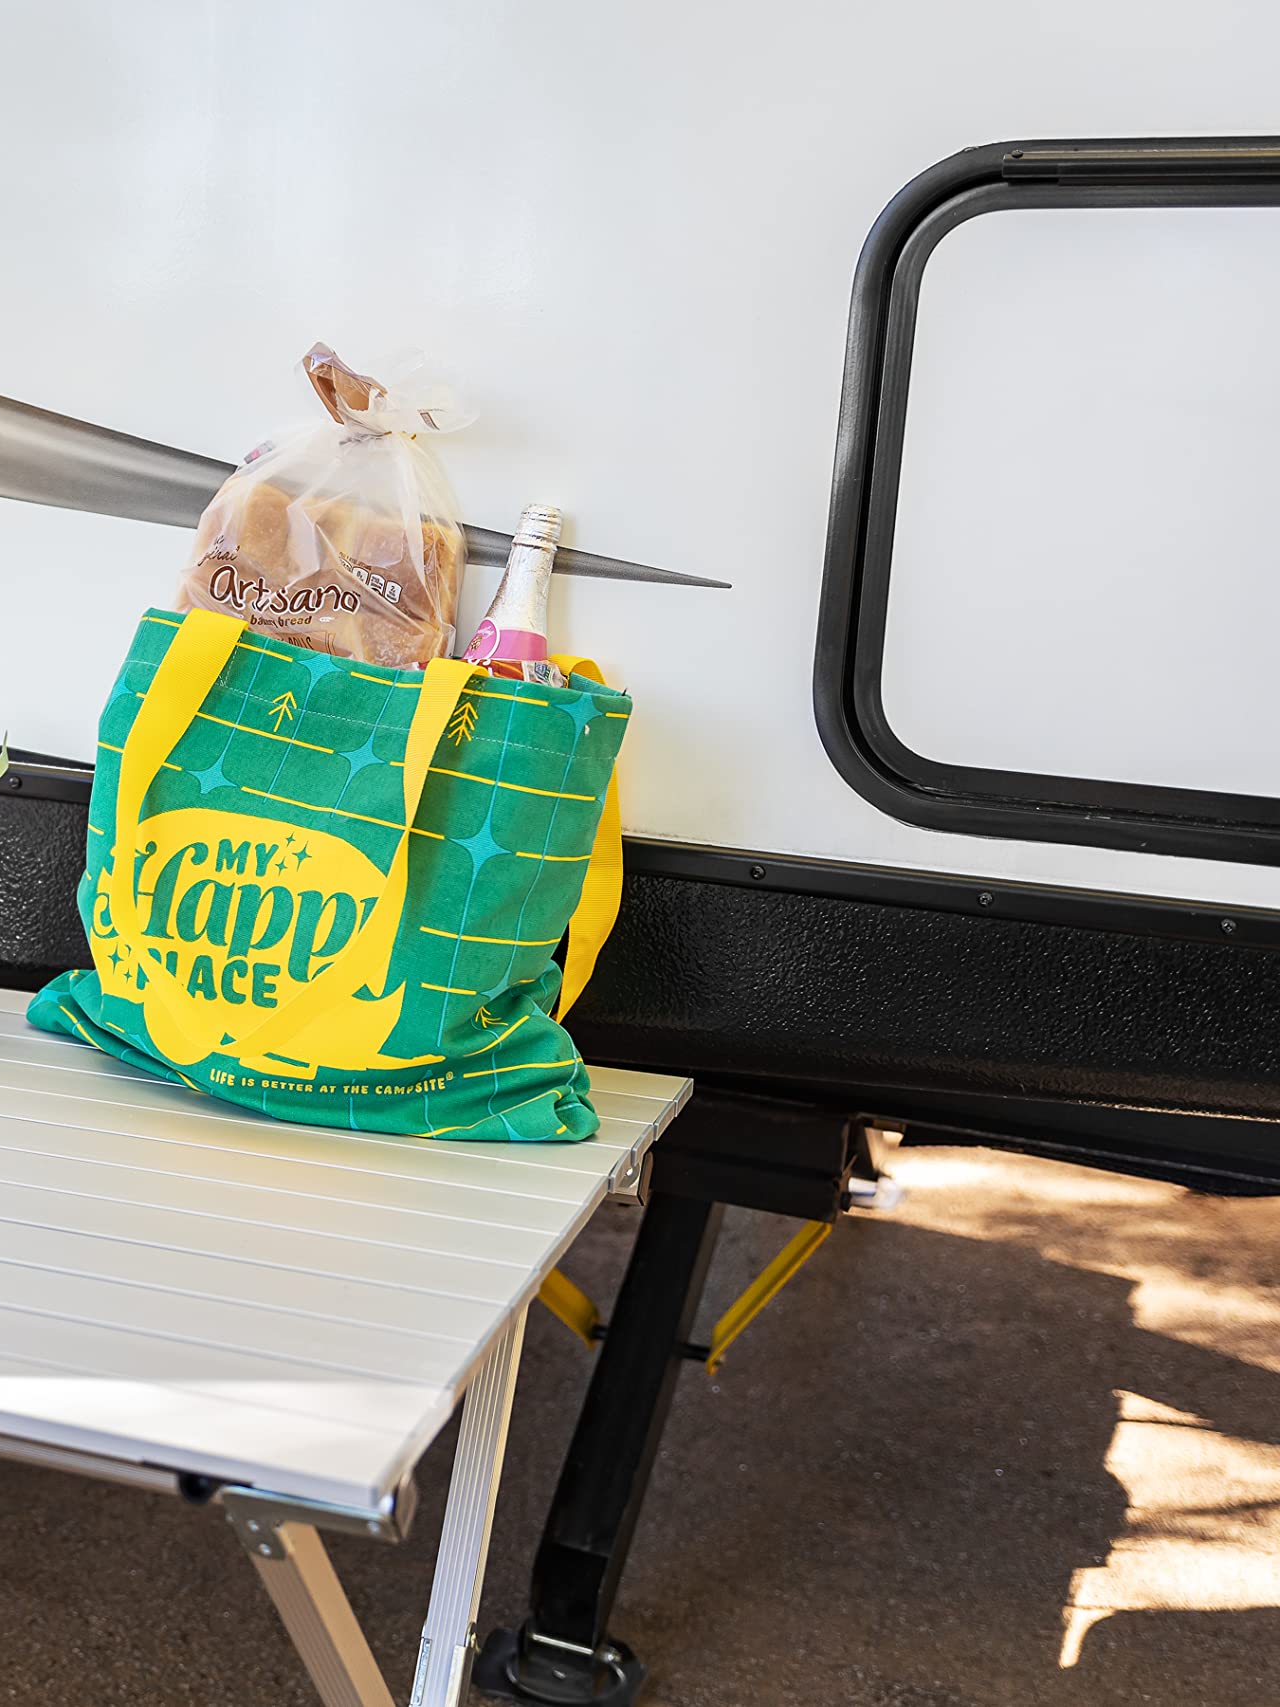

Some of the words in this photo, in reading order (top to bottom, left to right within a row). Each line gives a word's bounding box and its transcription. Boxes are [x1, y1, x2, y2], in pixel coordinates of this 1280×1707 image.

[214, 838, 280, 878] MY
[96, 838, 380, 984] Happ
[209, 1067, 235, 1087] LIFE
[241, 1077, 255, 1087] IS
[261, 1079, 313, 1093] BETTER
[319, 1084, 337, 1094] AT
[343, 1084, 369, 1095] THE
